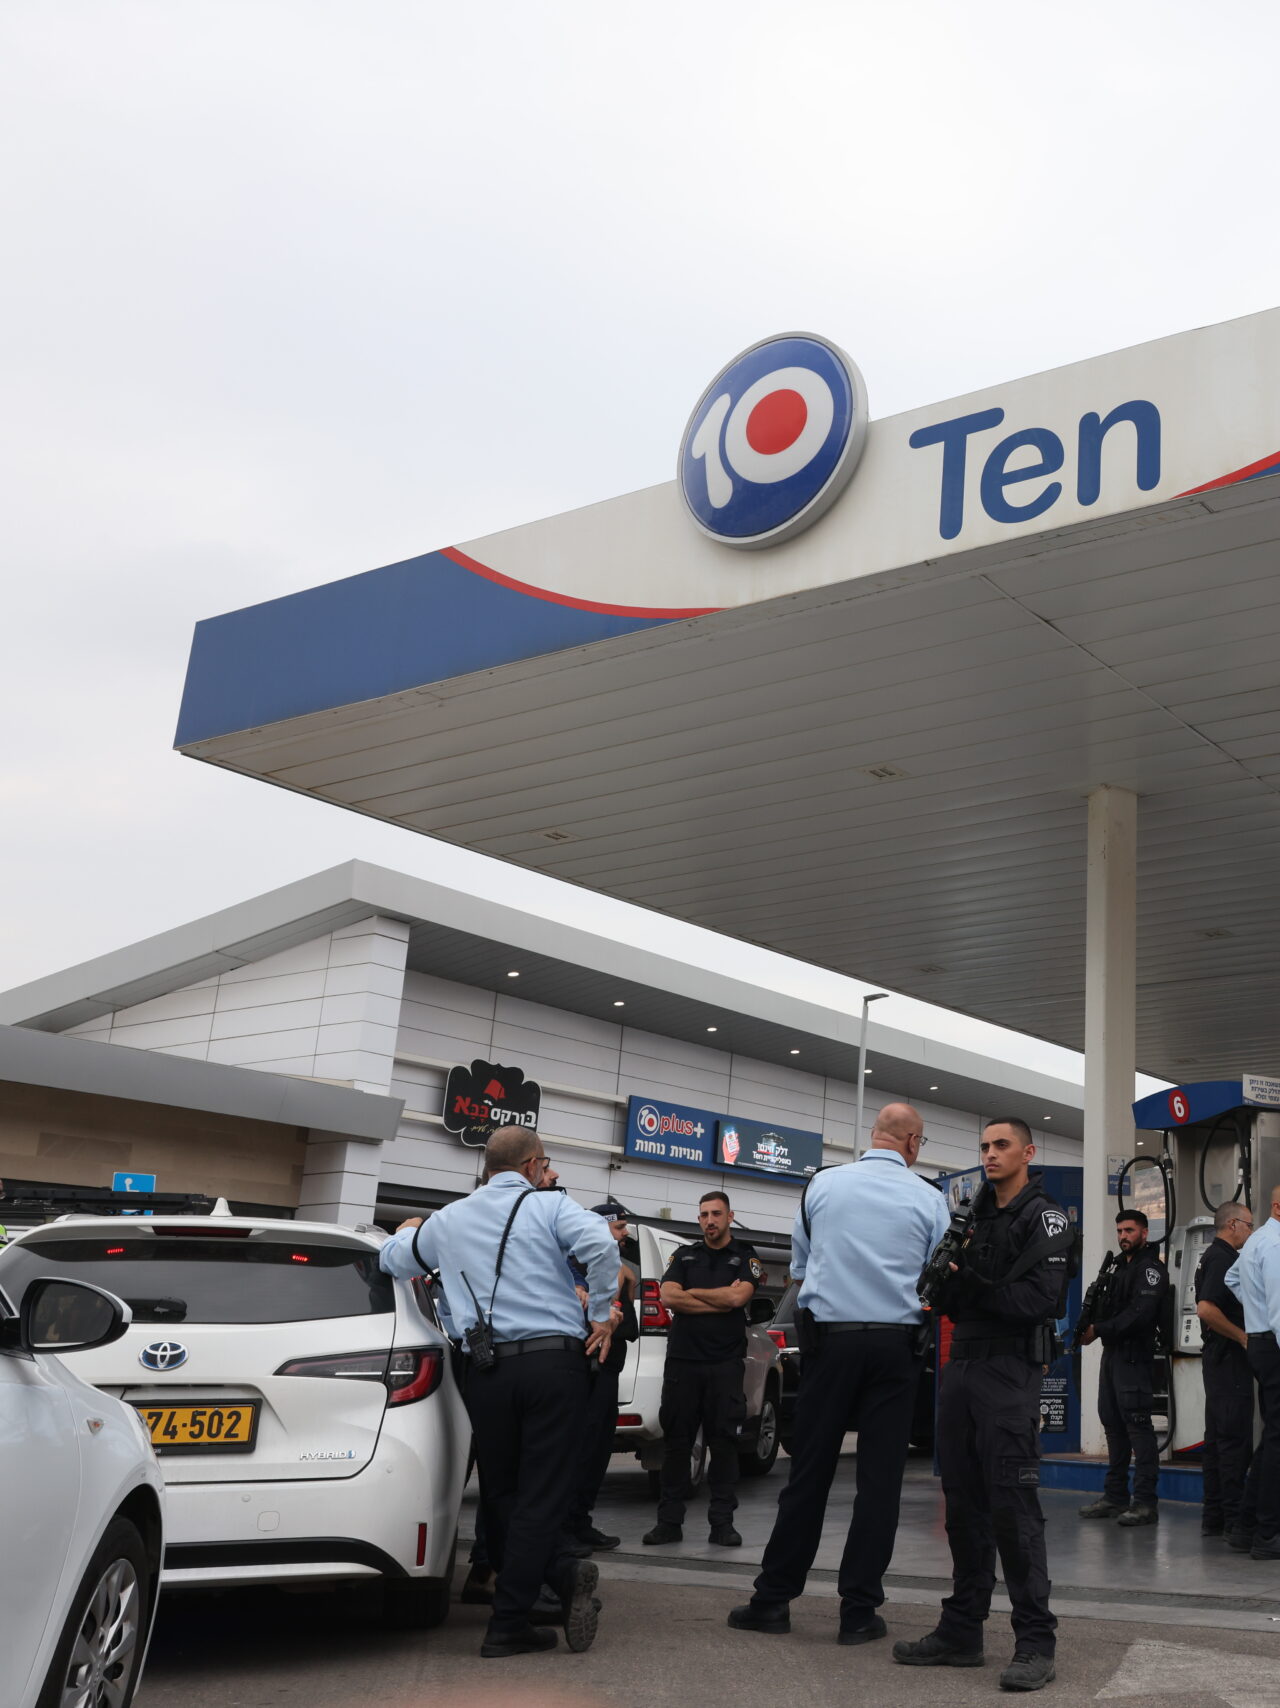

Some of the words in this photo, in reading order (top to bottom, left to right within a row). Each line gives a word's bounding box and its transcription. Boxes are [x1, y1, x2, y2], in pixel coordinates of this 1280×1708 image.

[691, 366, 834, 509] 10
[908, 399, 1161, 540] Ten
[1173, 1096, 1185, 1118] 6
[490, 1107, 537, 1128] בורקס
[634, 1139, 666, 1156] נוחות
[669, 1145, 703, 1162] חנויות
[299, 1451, 347, 1461] HYBRID
